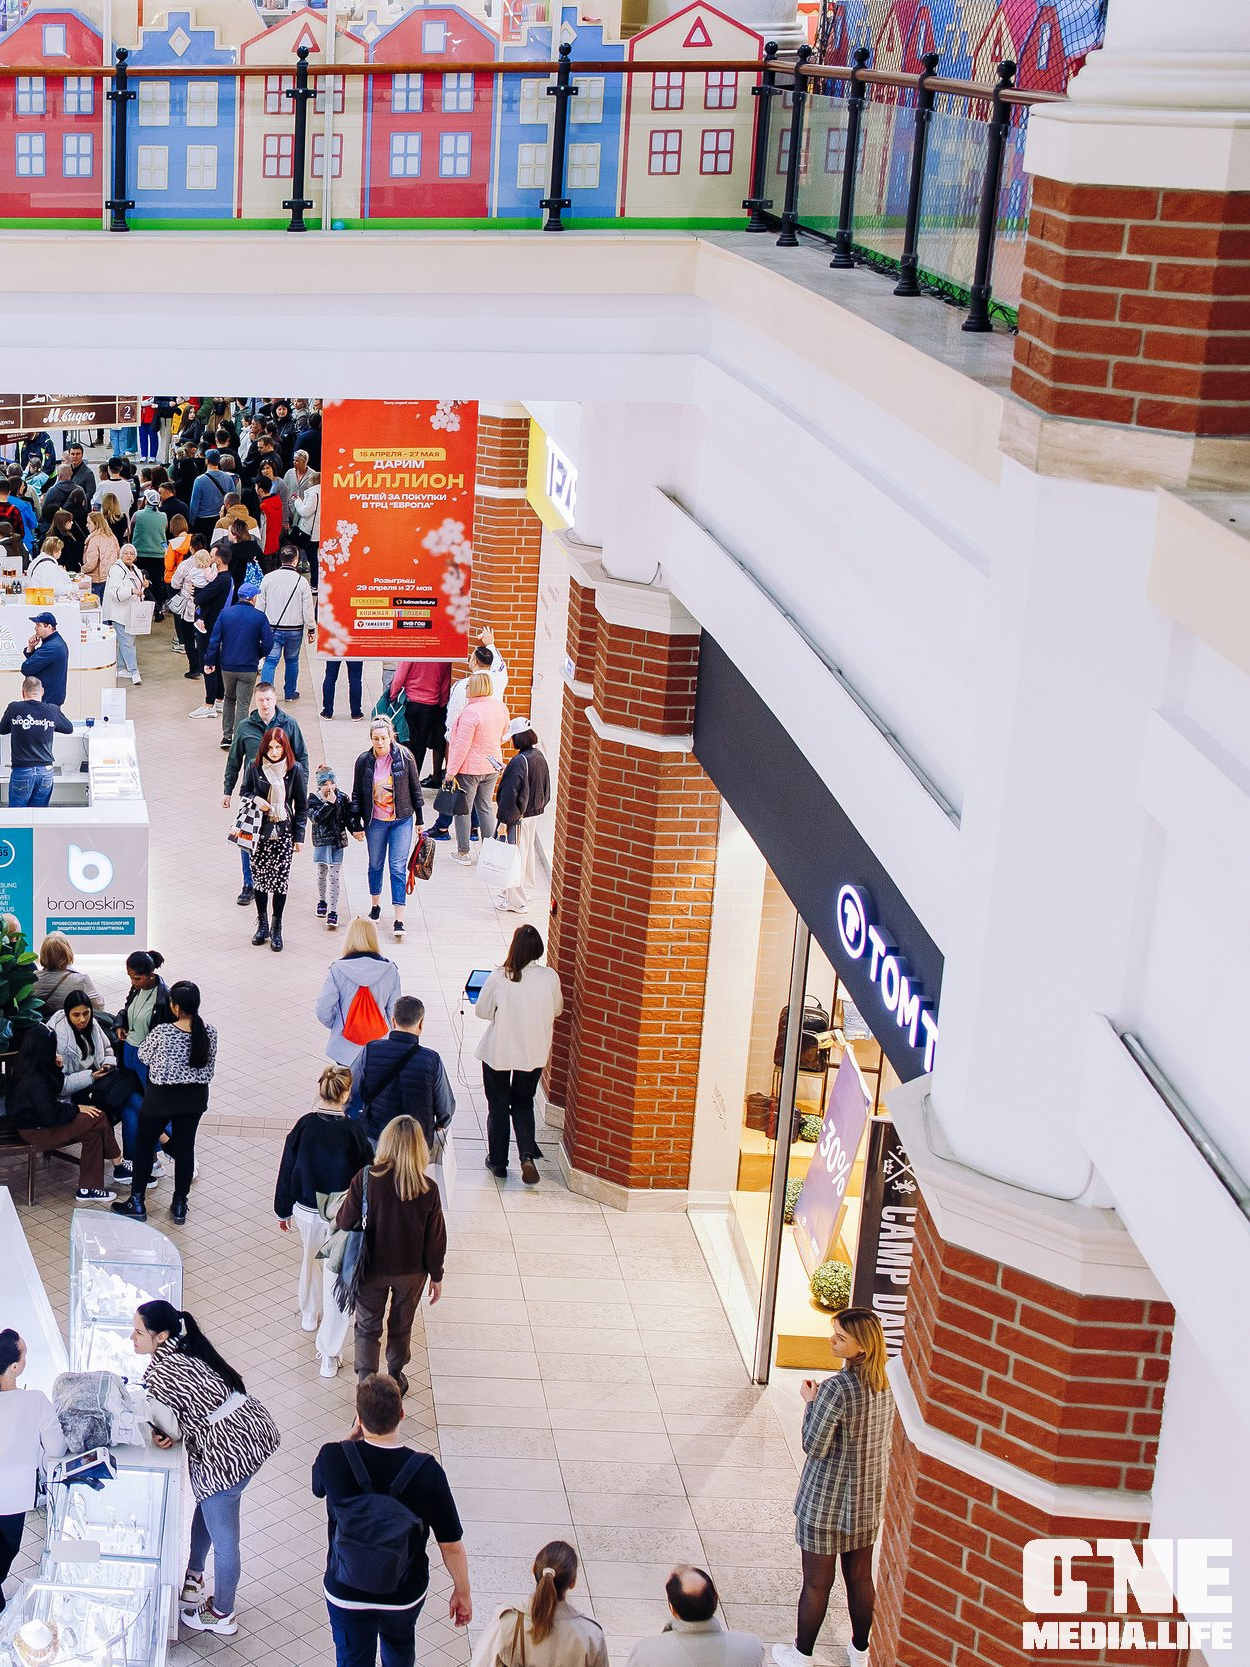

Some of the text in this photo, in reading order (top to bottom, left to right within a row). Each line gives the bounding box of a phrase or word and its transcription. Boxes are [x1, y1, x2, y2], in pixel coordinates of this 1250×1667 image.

[124, 405, 132, 416] 2
[373, 459, 425, 470] ДАРИМ
[333, 473, 464, 489] МИЛЛИОН
[350, 492, 387, 501] РУБЛЕЙ
[370, 502, 389, 510] ТРЦ
[373, 577, 416, 585] Розыгрыш
[47, 896, 135, 911] bronoskins
[875, 1205, 918, 1285] CAMP
